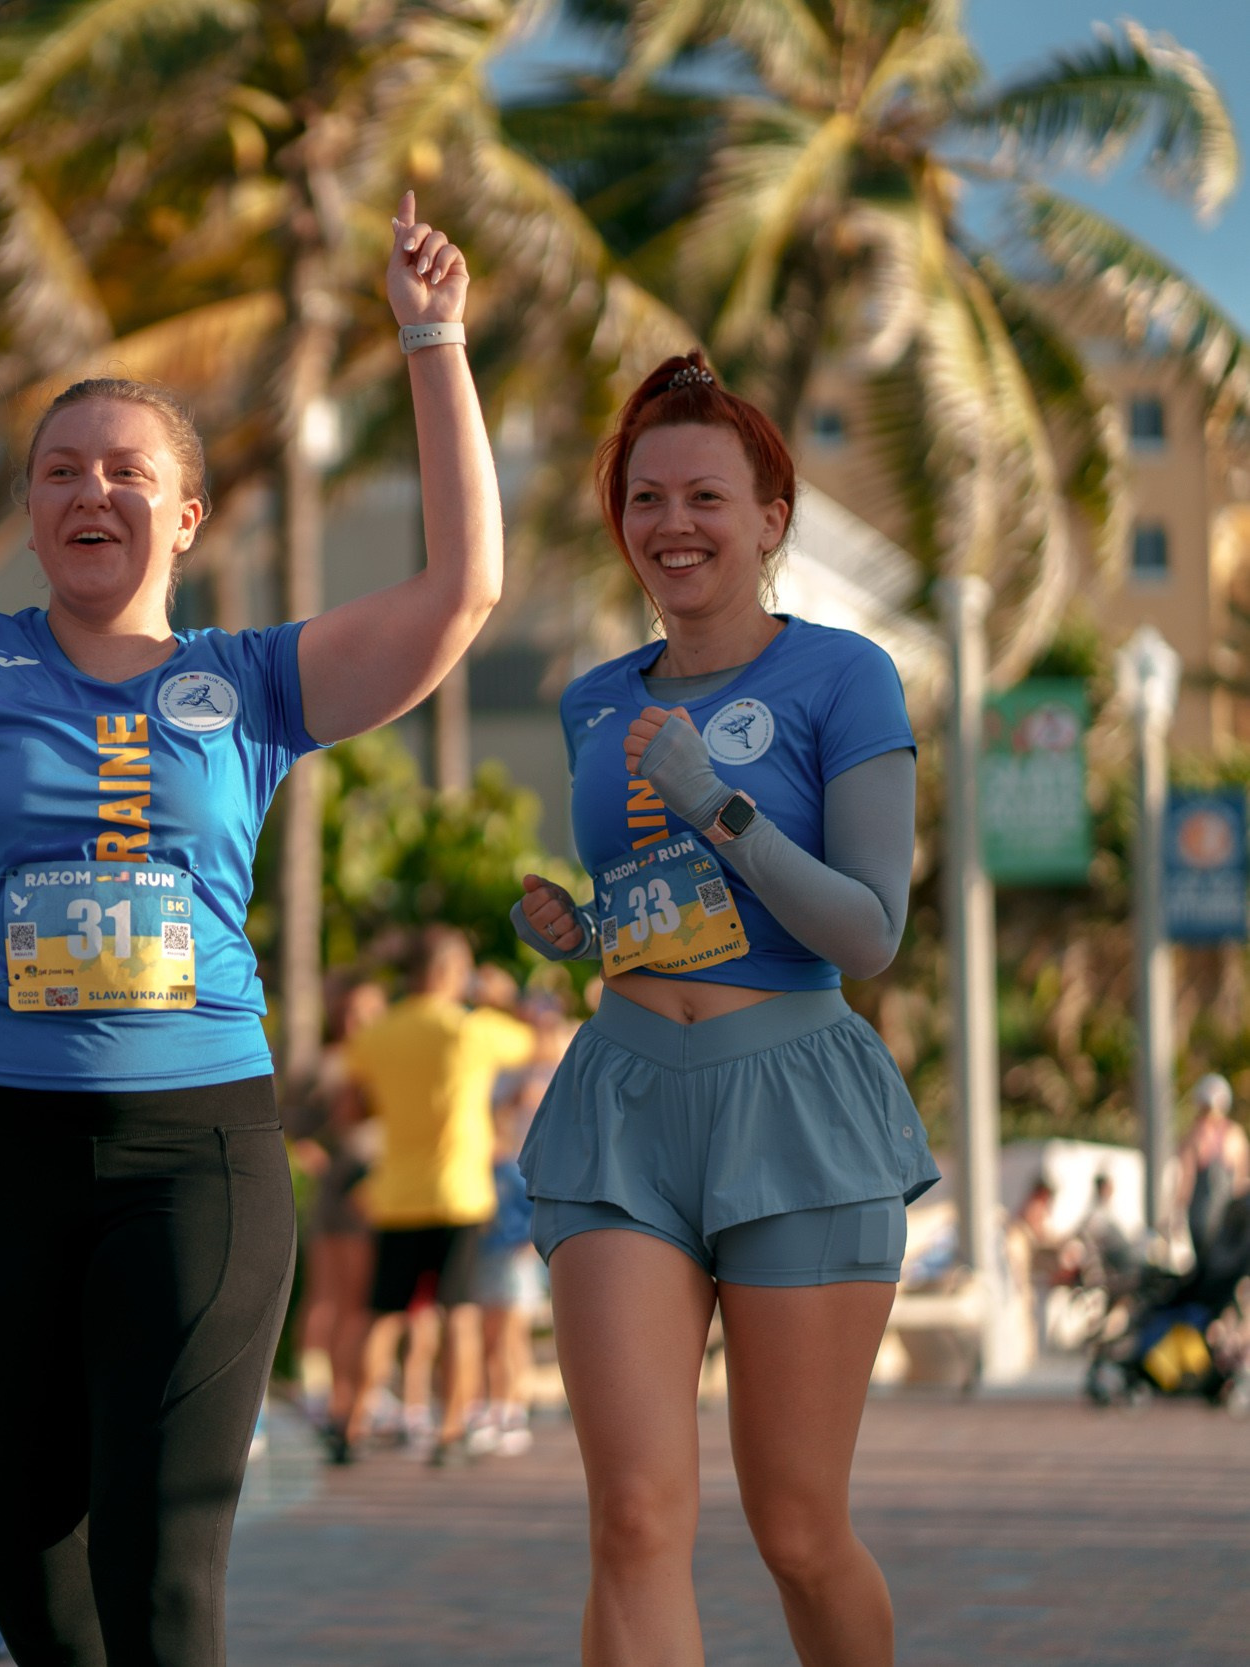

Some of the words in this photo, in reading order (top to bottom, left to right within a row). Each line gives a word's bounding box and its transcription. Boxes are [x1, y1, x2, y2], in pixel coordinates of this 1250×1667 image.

[203, 675, 220, 685] RUN
[96, 713, 151, 863] RAINE
[603, 860, 638, 885] RAZOM
[657, 839, 695, 862] RUN
[694, 860, 712, 873] 5K
[25, 871, 91, 887] RAZOM
[135, 871, 175, 888] RUN
[166, 901, 185, 913] 5K
[628, 878, 681, 943] 33
[66, 898, 131, 960] 31
[690, 939, 741, 964] UKRAINI!
[88, 991, 127, 1001] SLAVA
[130, 990, 188, 1001] UKRAINI!
